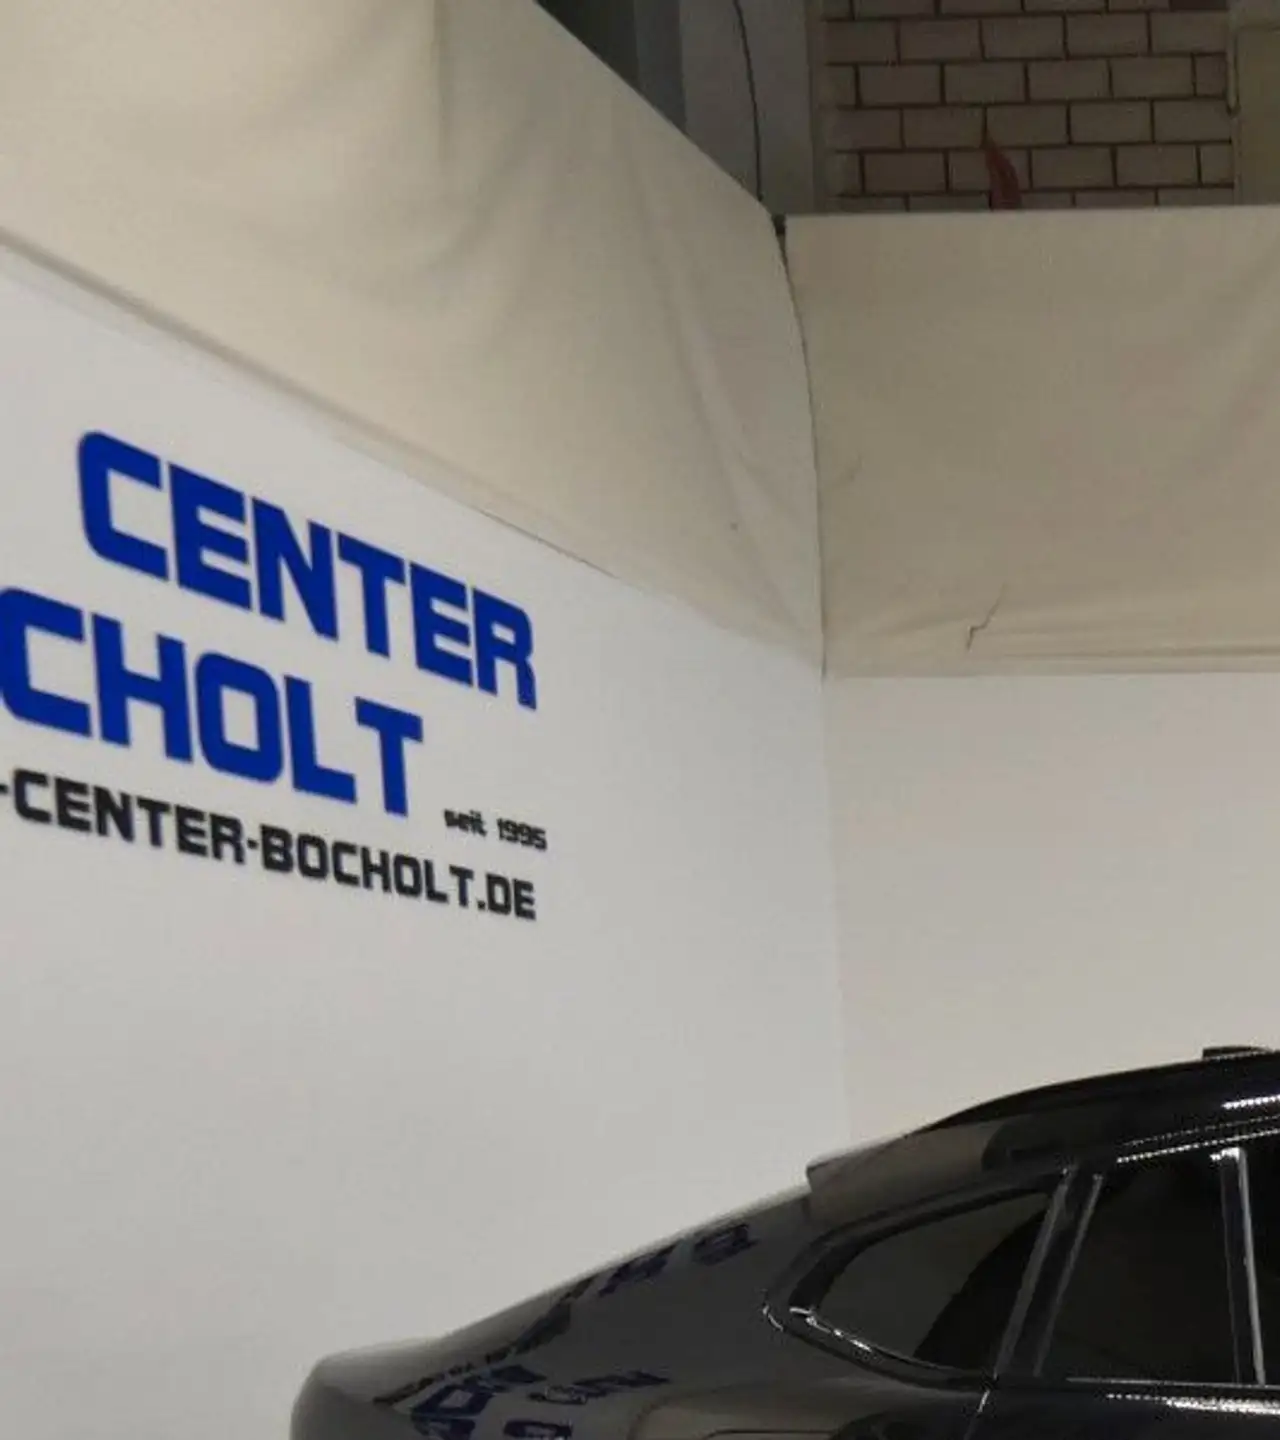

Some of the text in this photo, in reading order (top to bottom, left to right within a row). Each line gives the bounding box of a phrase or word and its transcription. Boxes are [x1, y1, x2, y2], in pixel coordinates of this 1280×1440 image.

[78, 431, 537, 709] CENTER
[443, 808, 548, 852] seit 1995
